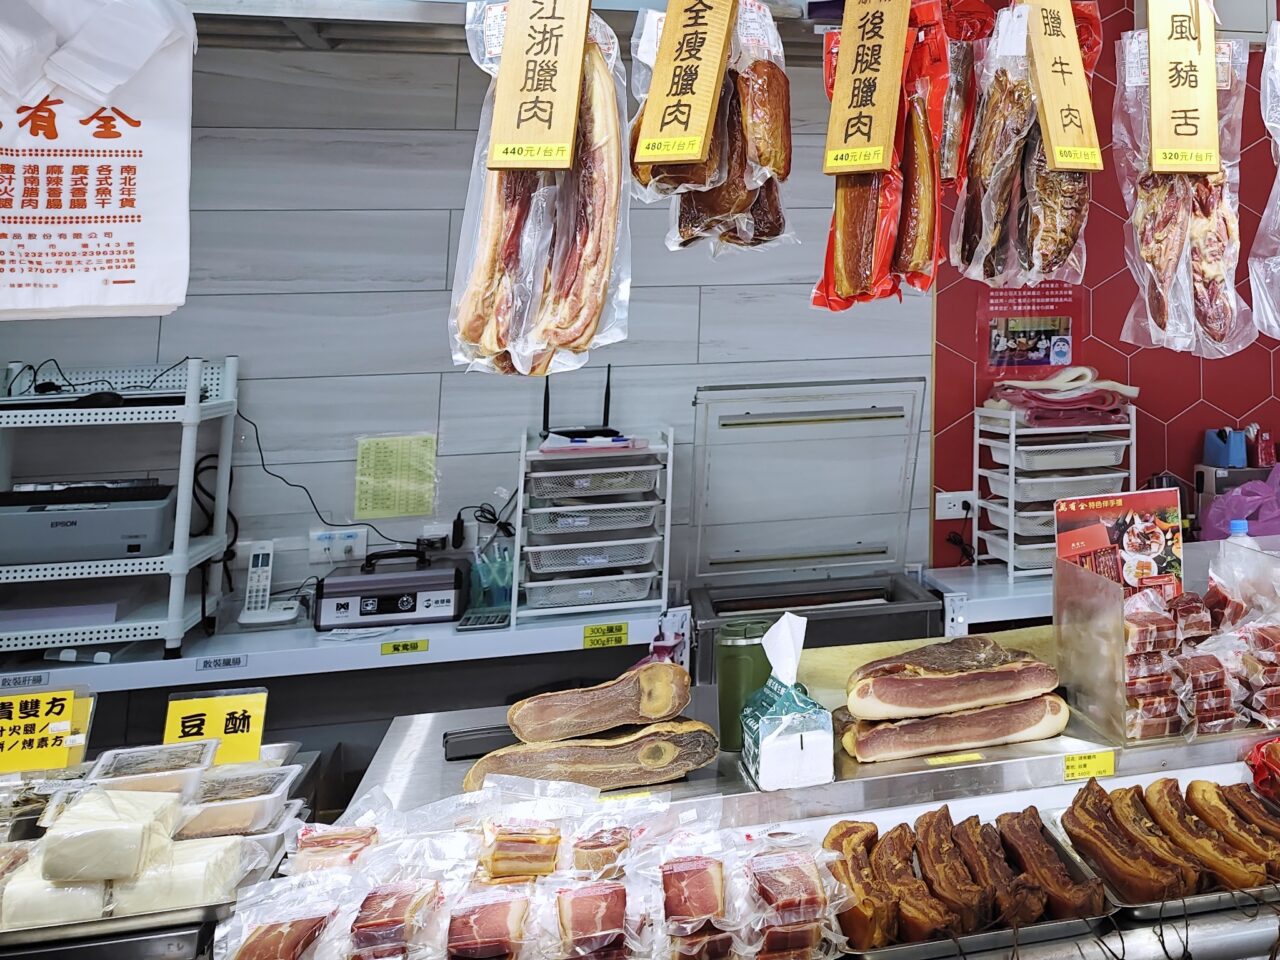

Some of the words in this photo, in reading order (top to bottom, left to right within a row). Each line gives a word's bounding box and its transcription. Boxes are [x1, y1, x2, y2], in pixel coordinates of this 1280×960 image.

[844, 10, 885, 144] 後腿臘肉
[1041, 7, 1084, 135] 臘牛肉
[1168, 14, 1200, 137] 風豬舌
[0, 94, 142, 140] 有全
[502, 146, 567, 157] 440元/台斤
[644, 140, 697, 151] 480元/台斤
[833, 150, 881, 162] 440元/台斤
[1058, 149, 1097, 160] 600元/台斤
[1162, 151, 1214, 161] 320元/台斤
[45, 164, 64, 209] 麻辣香腸
[69, 164, 90, 209] 廣式香腸
[95, 164, 113, 209] 各式魚干
[119, 164, 137, 209] 南北年貨
[51, 520, 78, 528] EPSON
